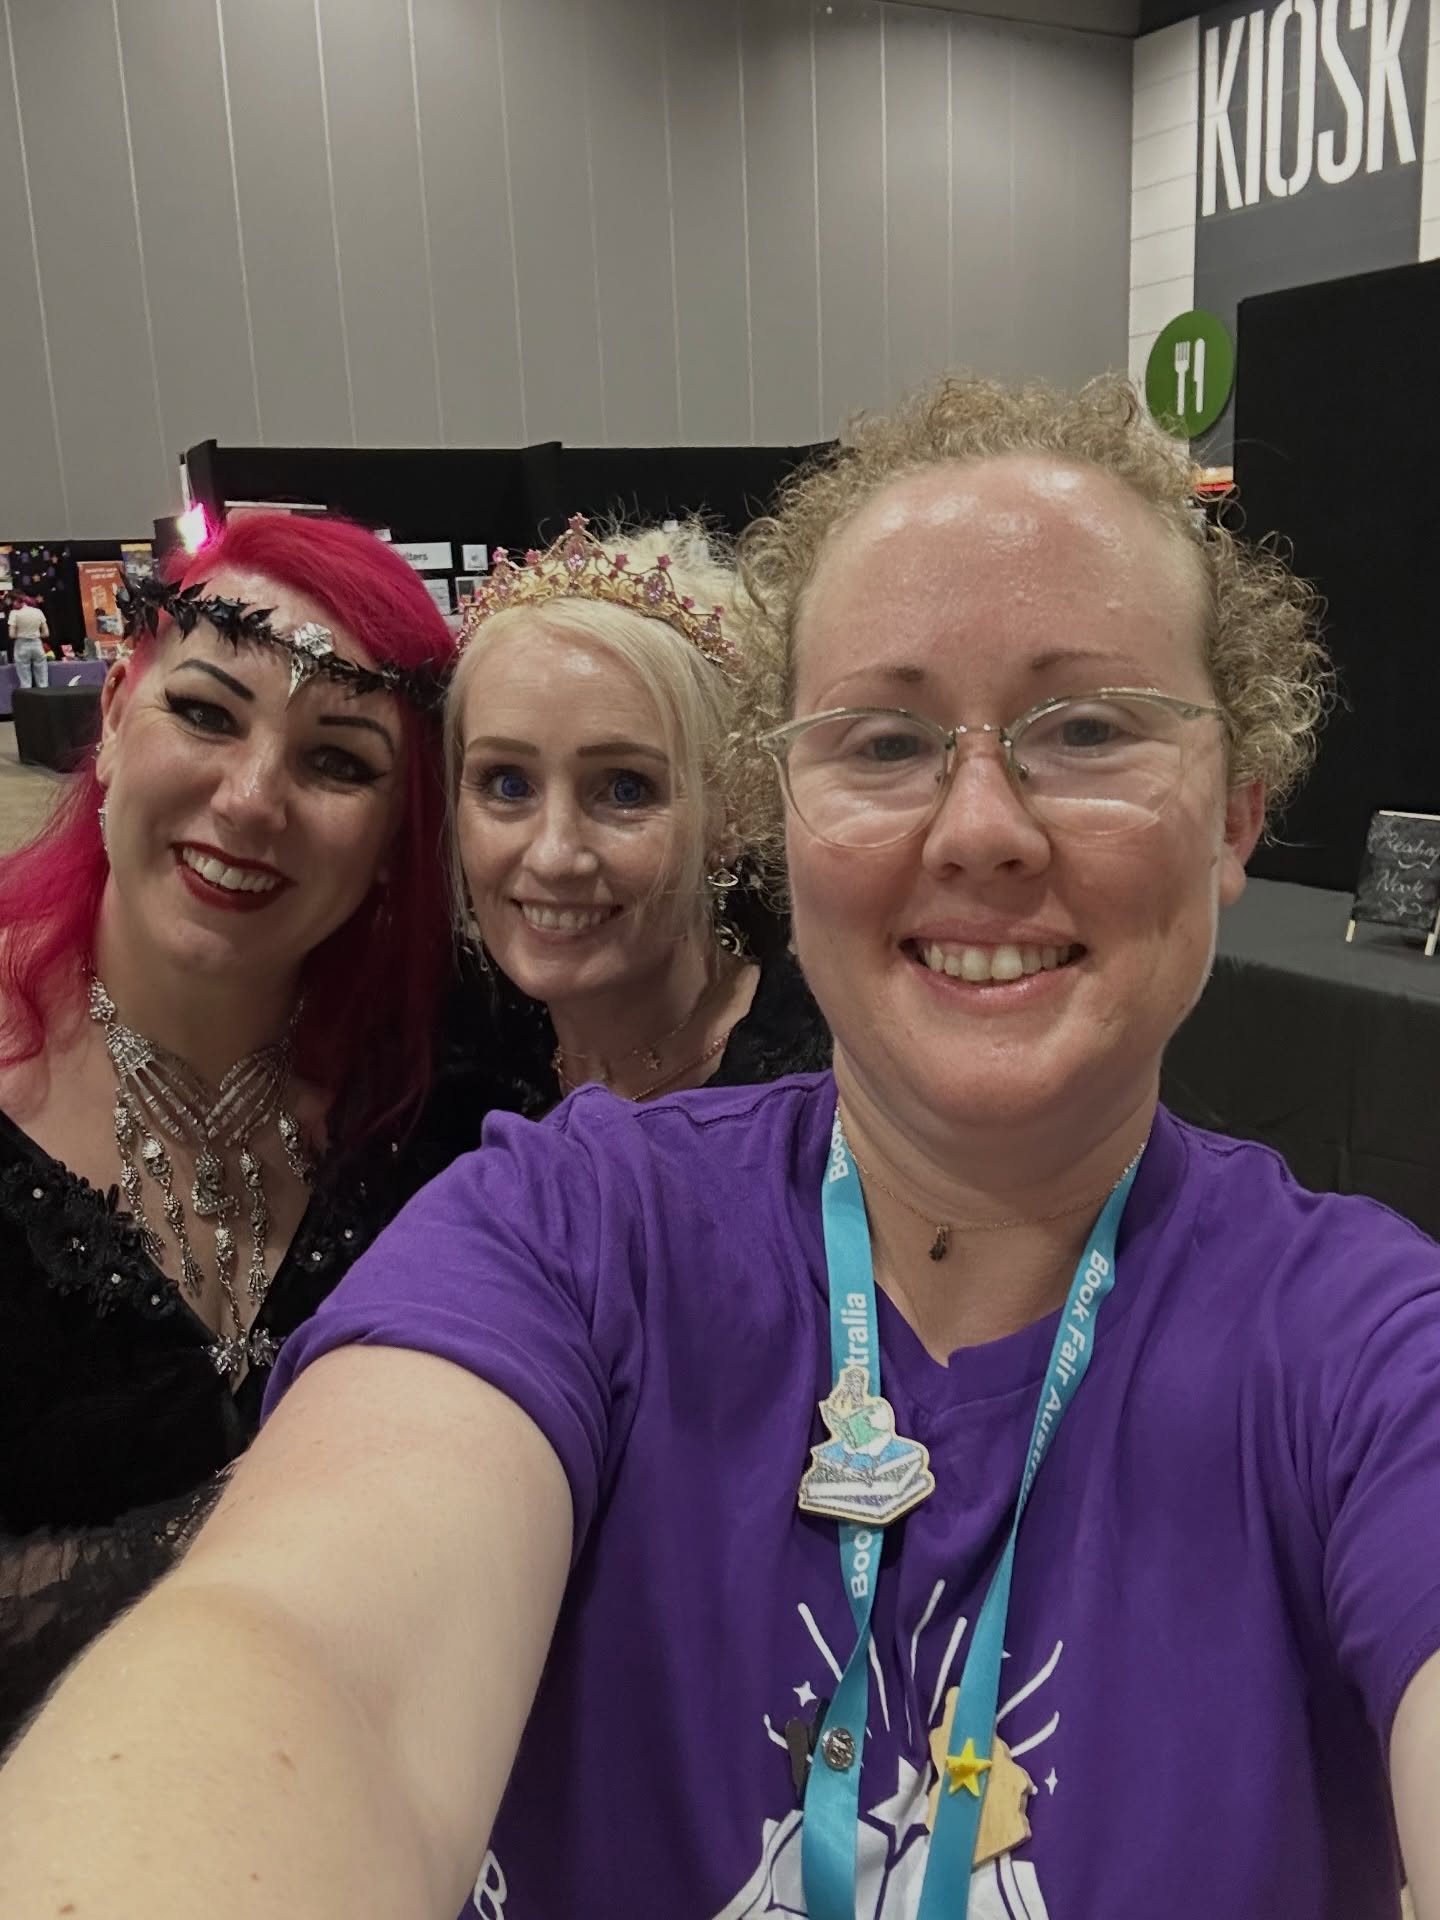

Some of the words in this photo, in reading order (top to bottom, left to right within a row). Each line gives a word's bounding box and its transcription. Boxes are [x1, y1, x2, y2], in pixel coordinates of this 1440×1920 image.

[1202, 0, 1417, 217] KIOSK
[1071, 1249, 1110, 1324] Book
[841, 1293, 870, 1366] tralia
[1055, 1323, 1087, 1387] Fair
[1020, 1384, 1062, 1512] Austr
[850, 1530, 873, 1599] Boo
